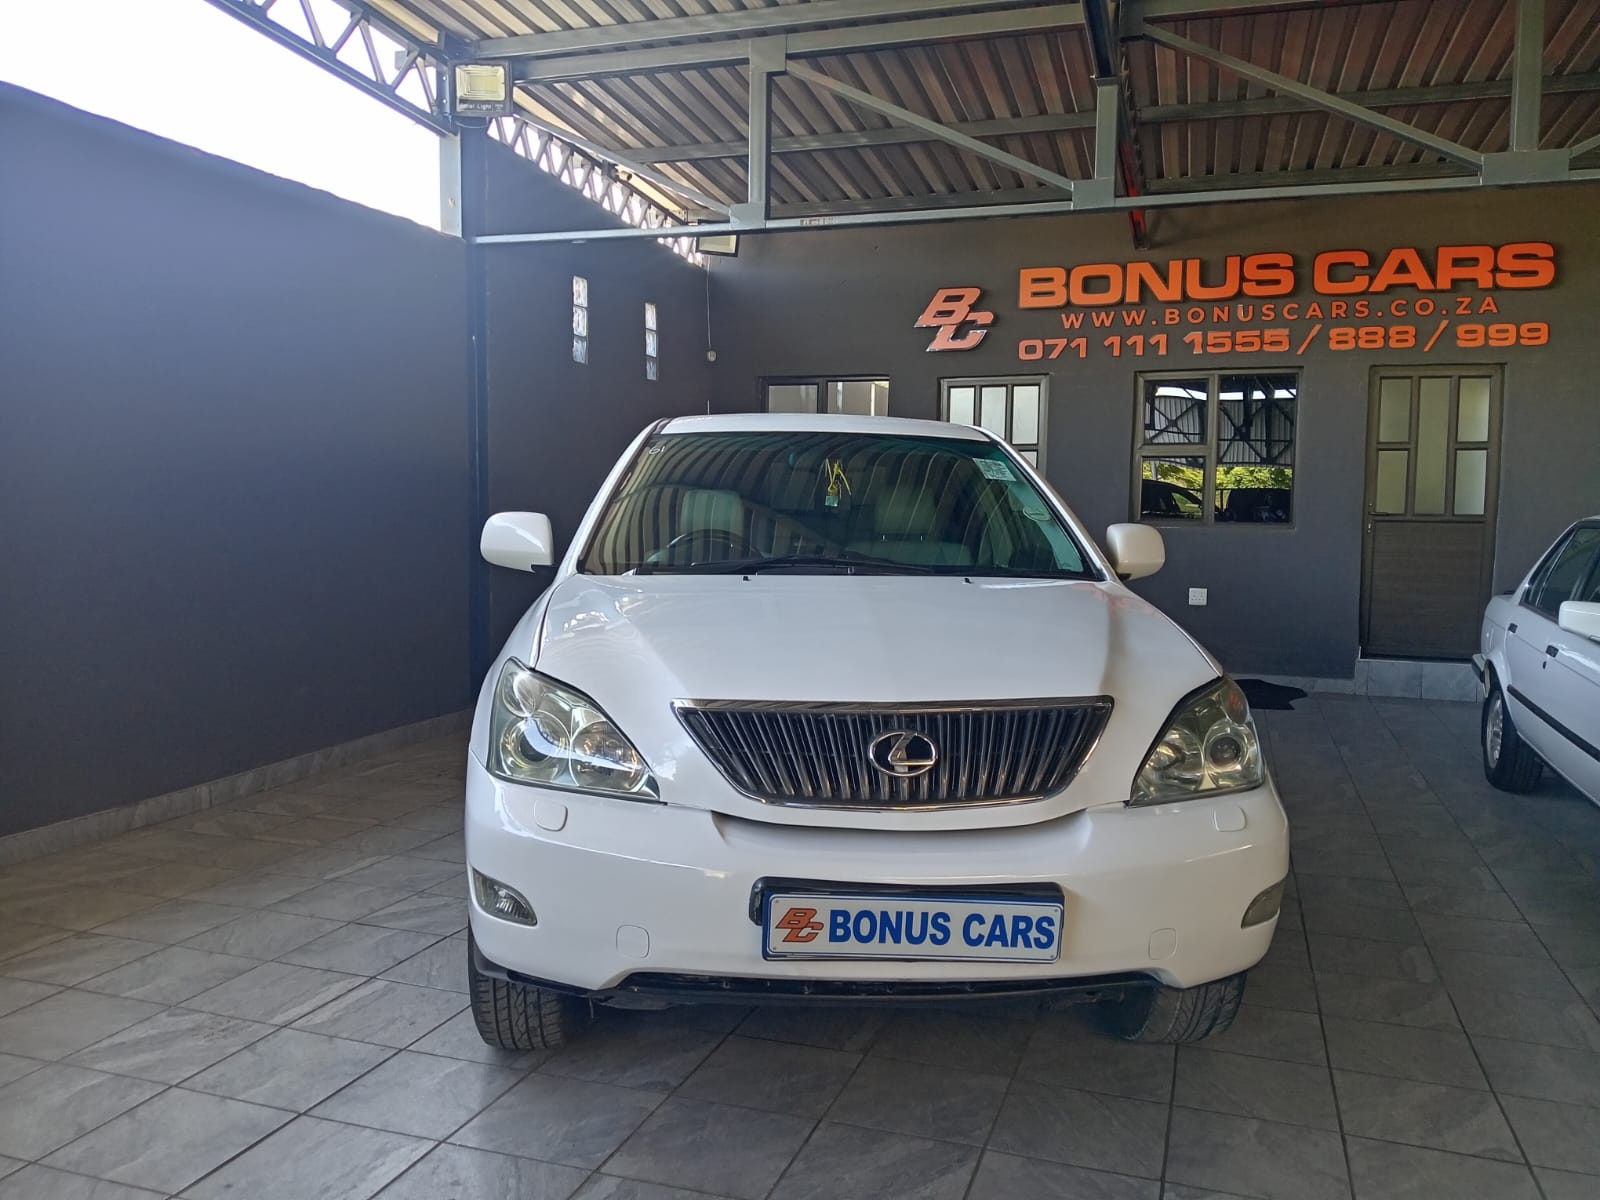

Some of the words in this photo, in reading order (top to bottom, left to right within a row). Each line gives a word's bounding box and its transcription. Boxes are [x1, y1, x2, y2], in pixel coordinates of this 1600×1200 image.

[1018, 252, 1295, 309] BONUS
[1312, 241, 1556, 295] CARS
[1060, 296, 1499, 329] WWW.BONUSCARS.CO.ZA
[1018, 336, 1088, 361] 071
[1103, 333, 1168, 357] 111
[828, 909, 951, 945] BONUS
[962, 913, 1056, 949] CARS
